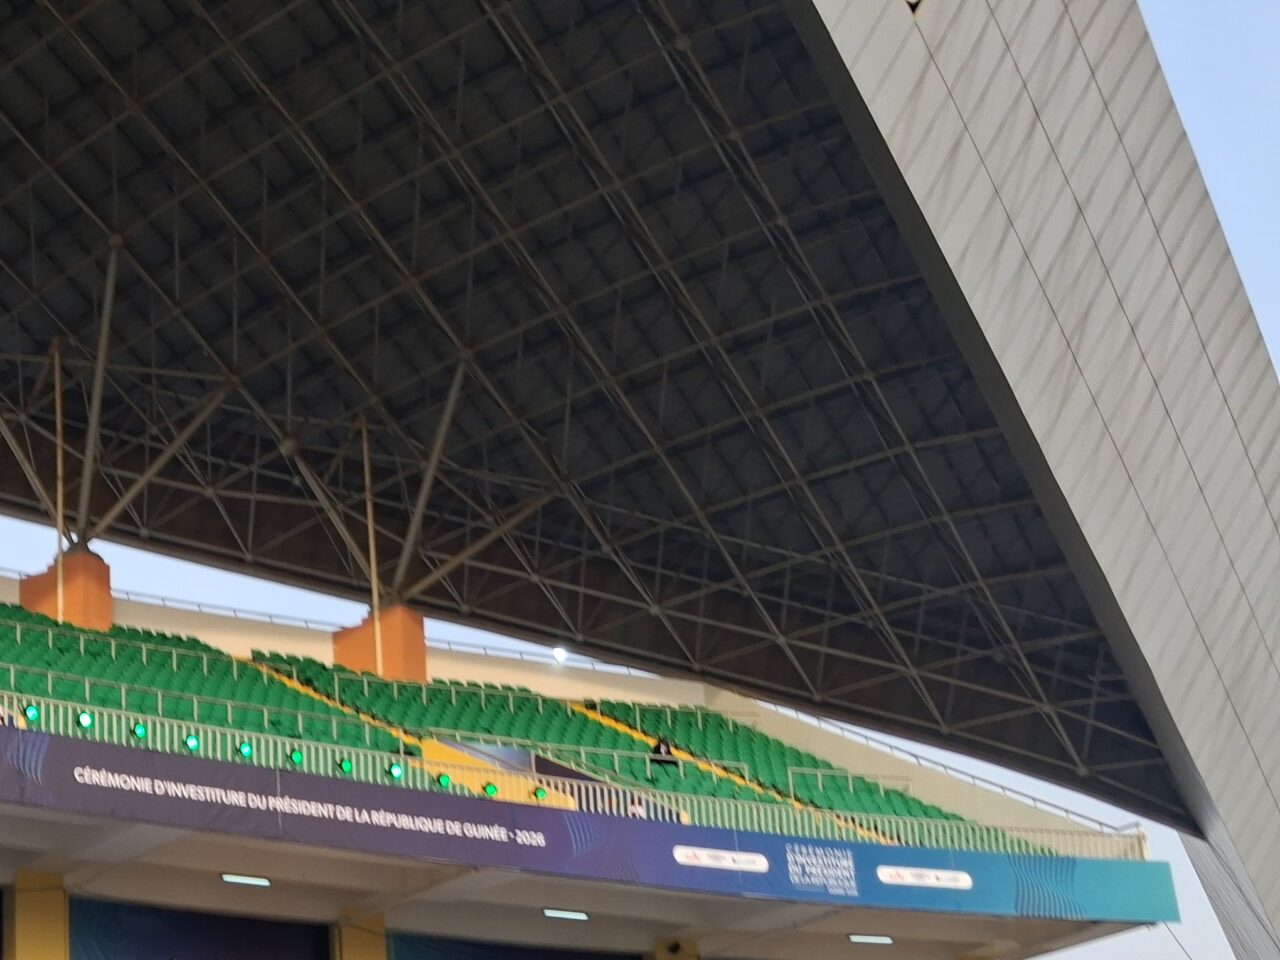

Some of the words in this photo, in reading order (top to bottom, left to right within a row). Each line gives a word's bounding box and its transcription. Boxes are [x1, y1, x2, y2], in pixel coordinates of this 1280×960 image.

[74, 766, 153, 795] CÉRÉMONIE
[154, 779, 247, 808] D'INVESTITURE
[247, 793, 267, 811] DU
[268, 795, 335, 820] PRÉSIDENT
[336, 804, 355, 822] DE
[355, 807, 371, 824] LA
[371, 808, 445, 834] RÉPUBLIQUE
[445, 820, 463, 837] DE
[463, 822, 509, 843] GUINÉE
[516, 830, 546, 847] 2026
